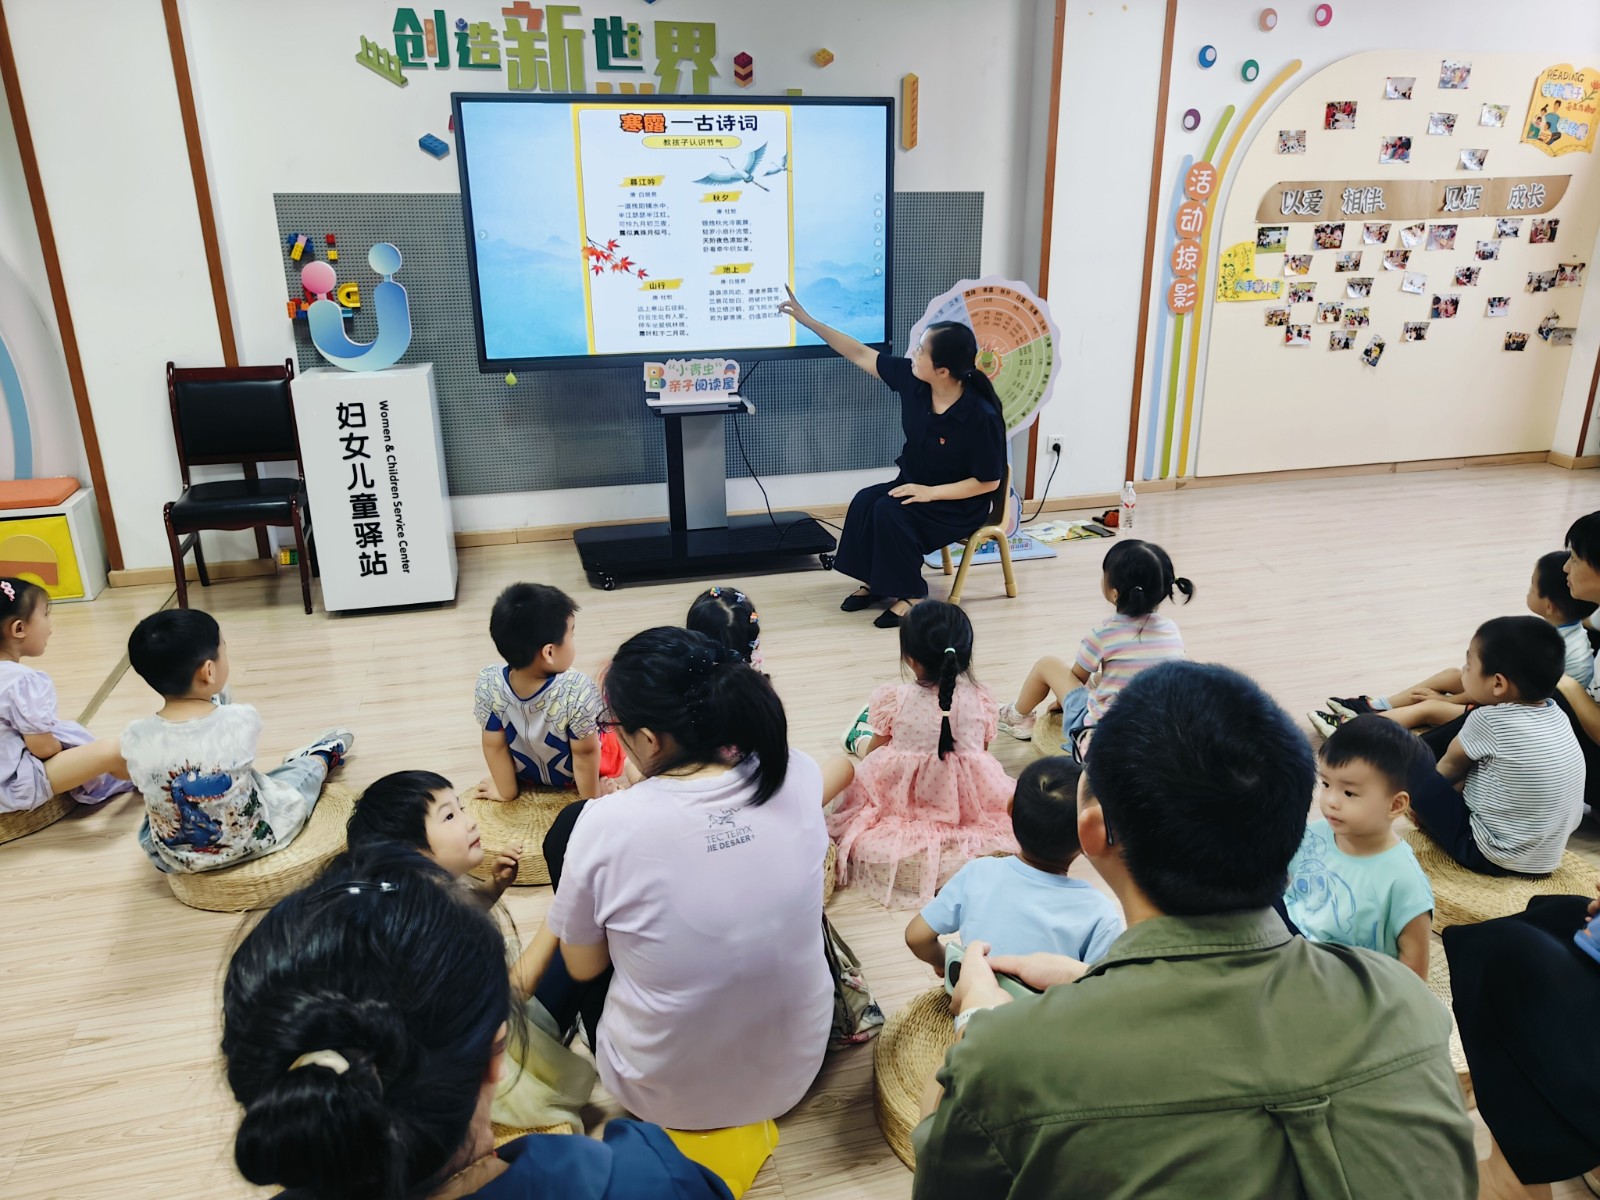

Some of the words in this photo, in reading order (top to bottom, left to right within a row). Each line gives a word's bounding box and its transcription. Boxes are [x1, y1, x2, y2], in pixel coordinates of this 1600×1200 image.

[393, 1, 719, 94] 创造新世界
[1547, 69, 1585, 83] READING
[663, 138, 724, 147] 教孩子认识节气
[630, 178, 655, 186] 暮江吟
[713, 194, 729, 202] 秋夕
[1281, 189, 1324, 215] 以爱
[1443, 185, 1482, 211] 见证
[1507, 184, 1545, 209] 成长
[1173, 168, 1213, 309] 活动掠影
[723, 266, 739, 274] 池上
[649, 282, 665, 290] 山行
[669, 377, 735, 393] 亲子阅读屋
[379, 400, 391, 442] Women
[385, 444, 395, 453] &
[386, 455, 403, 499] Children
[336, 402, 388, 577] 妇女儿童驿站
[393, 501, 406, 538] Service
[399, 540, 410, 574] Center
[707, 844, 718, 853] JIE
